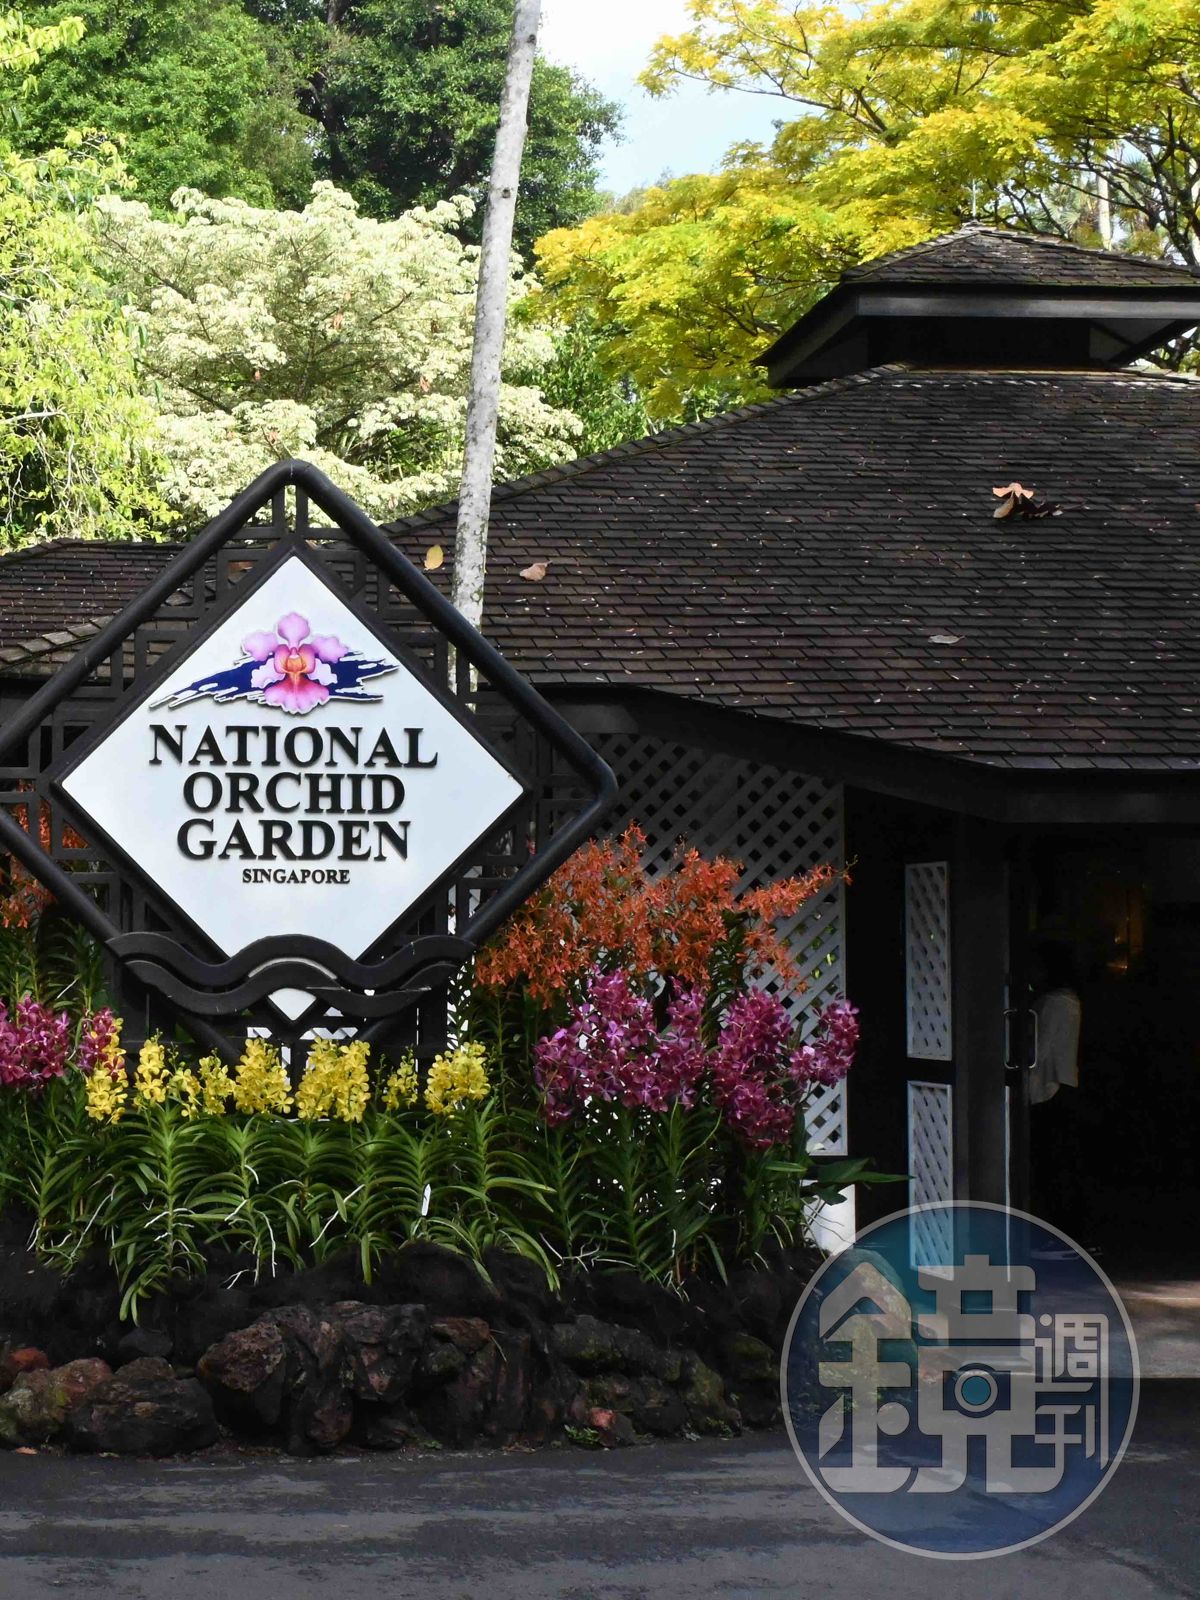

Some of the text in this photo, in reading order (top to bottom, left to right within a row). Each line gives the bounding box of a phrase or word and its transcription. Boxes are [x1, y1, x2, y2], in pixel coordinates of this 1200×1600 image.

[148, 724, 438, 769] NATIONAL
[183, 772, 405, 814] ORCHID
[176, 819, 411, 862] GARDEN
[242, 868, 351, 885] SINGAPORE
